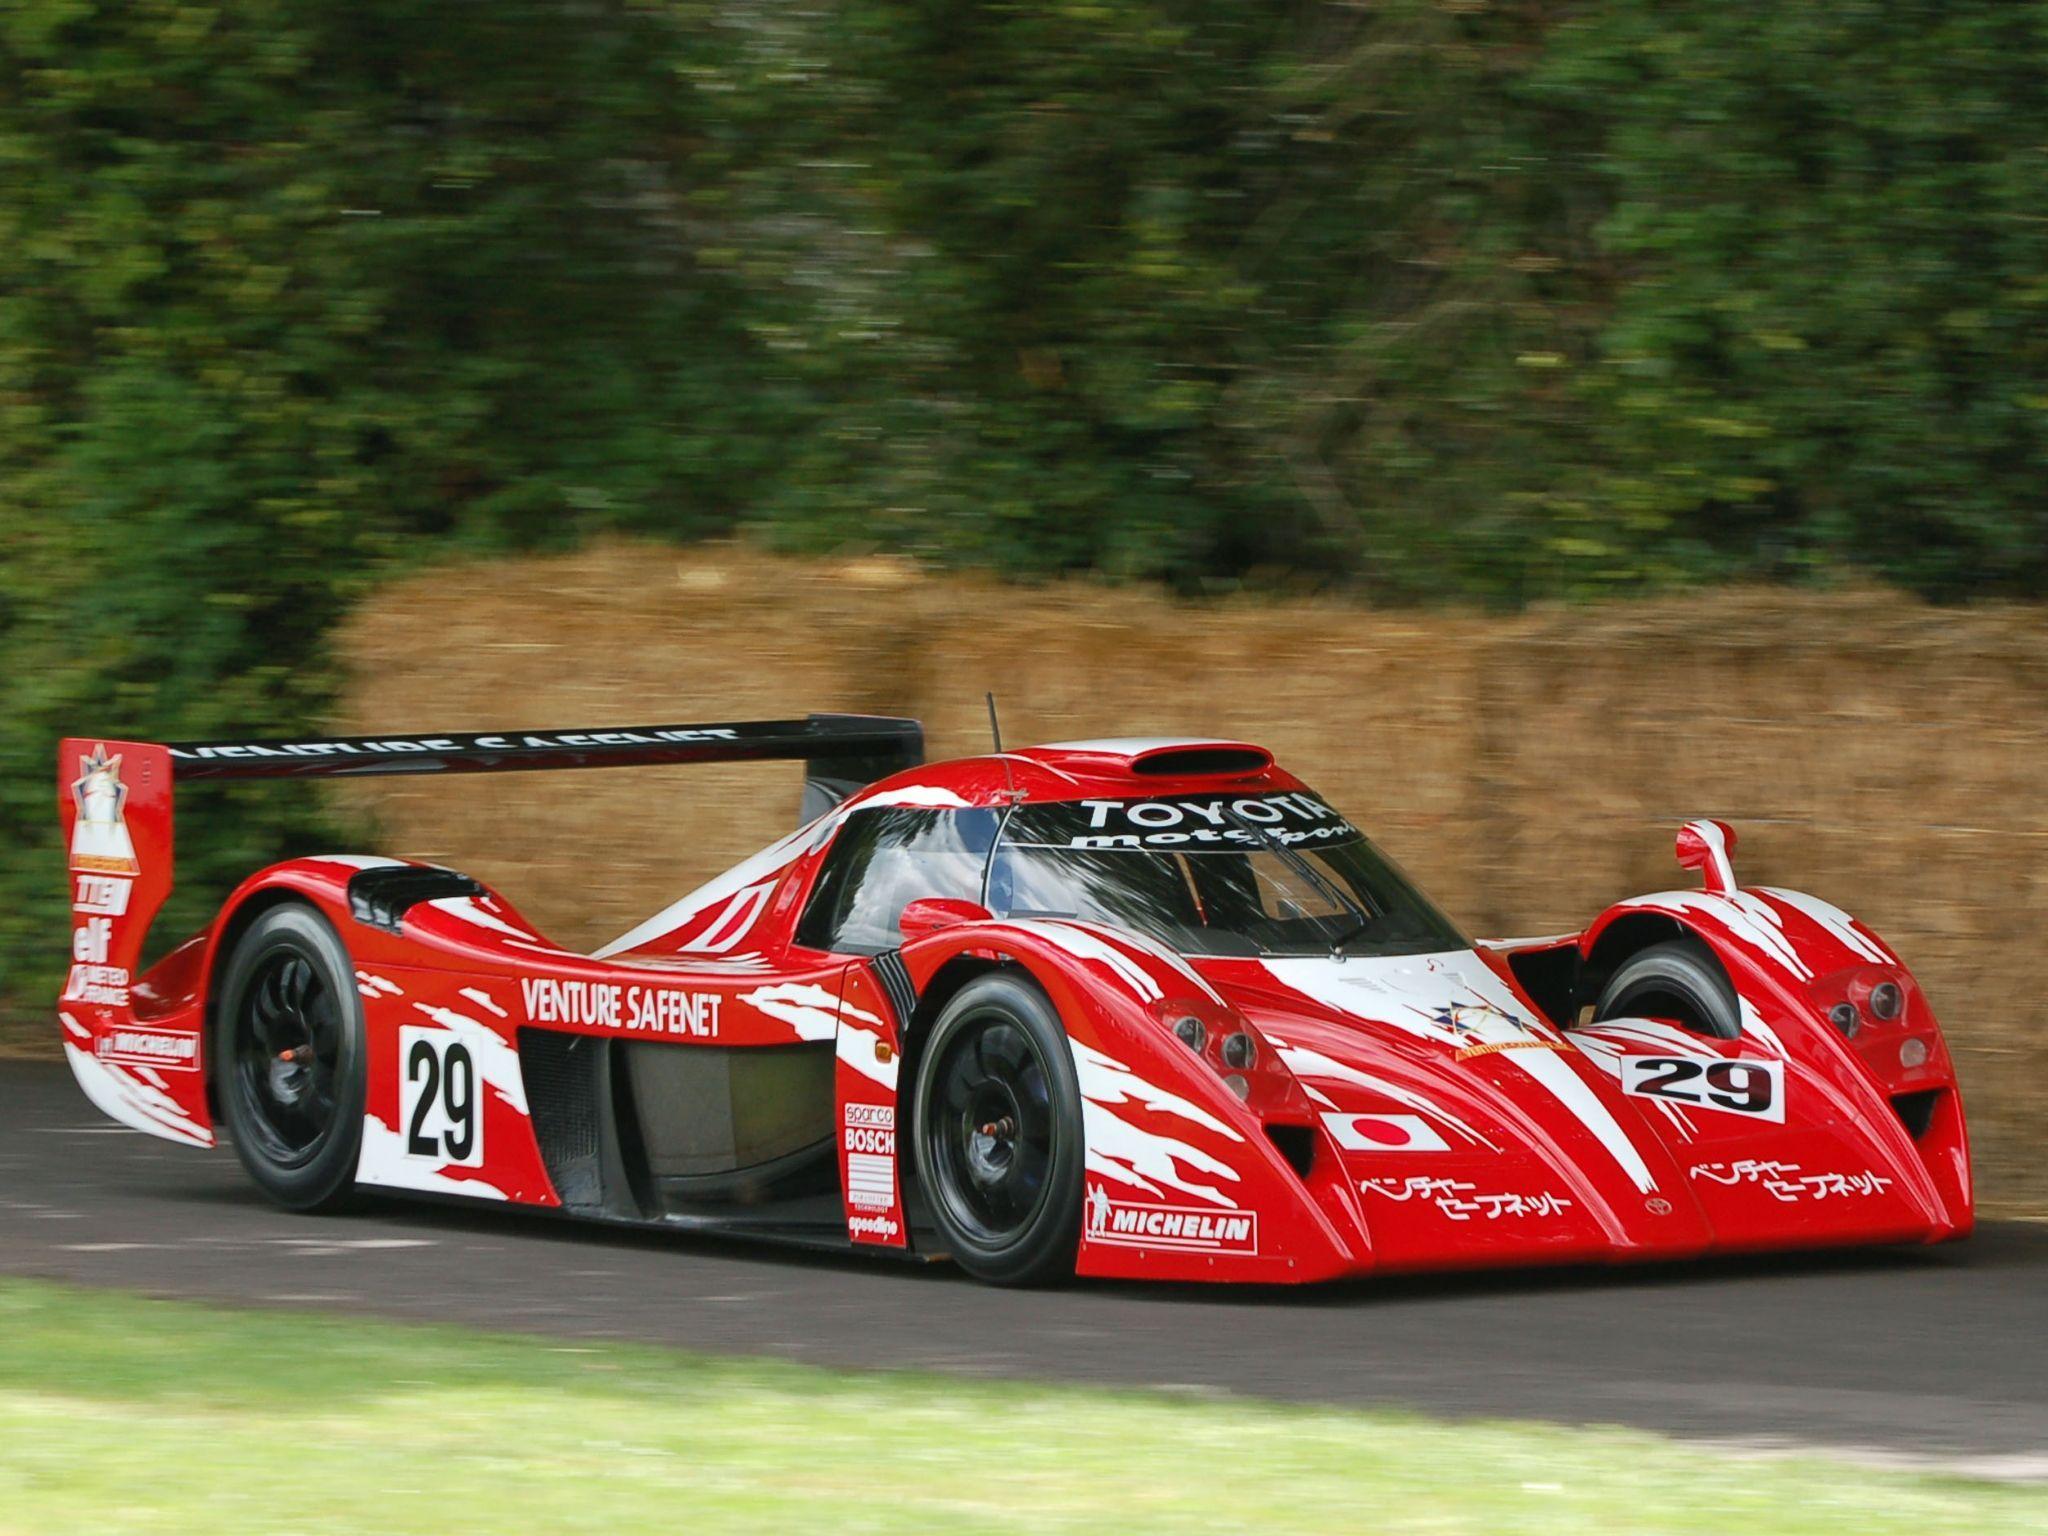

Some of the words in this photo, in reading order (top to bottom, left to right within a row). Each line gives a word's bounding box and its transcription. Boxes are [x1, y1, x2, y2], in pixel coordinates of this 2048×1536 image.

[1081, 792, 1337, 828] TOYOTA
[1071, 818, 1356, 849] motosport
[73, 917, 112, 963] elf
[521, 978, 621, 1028] VENTURE
[626, 986, 722, 1037] SAFENET
[408, 1039, 474, 1160] 29
[1635, 1059, 1772, 1112] 29
[846, 1106, 893, 1123] sparco
[845, 1128, 895, 1154] BOSCH
[1112, 1209, 1250, 1241] MICHELIN
